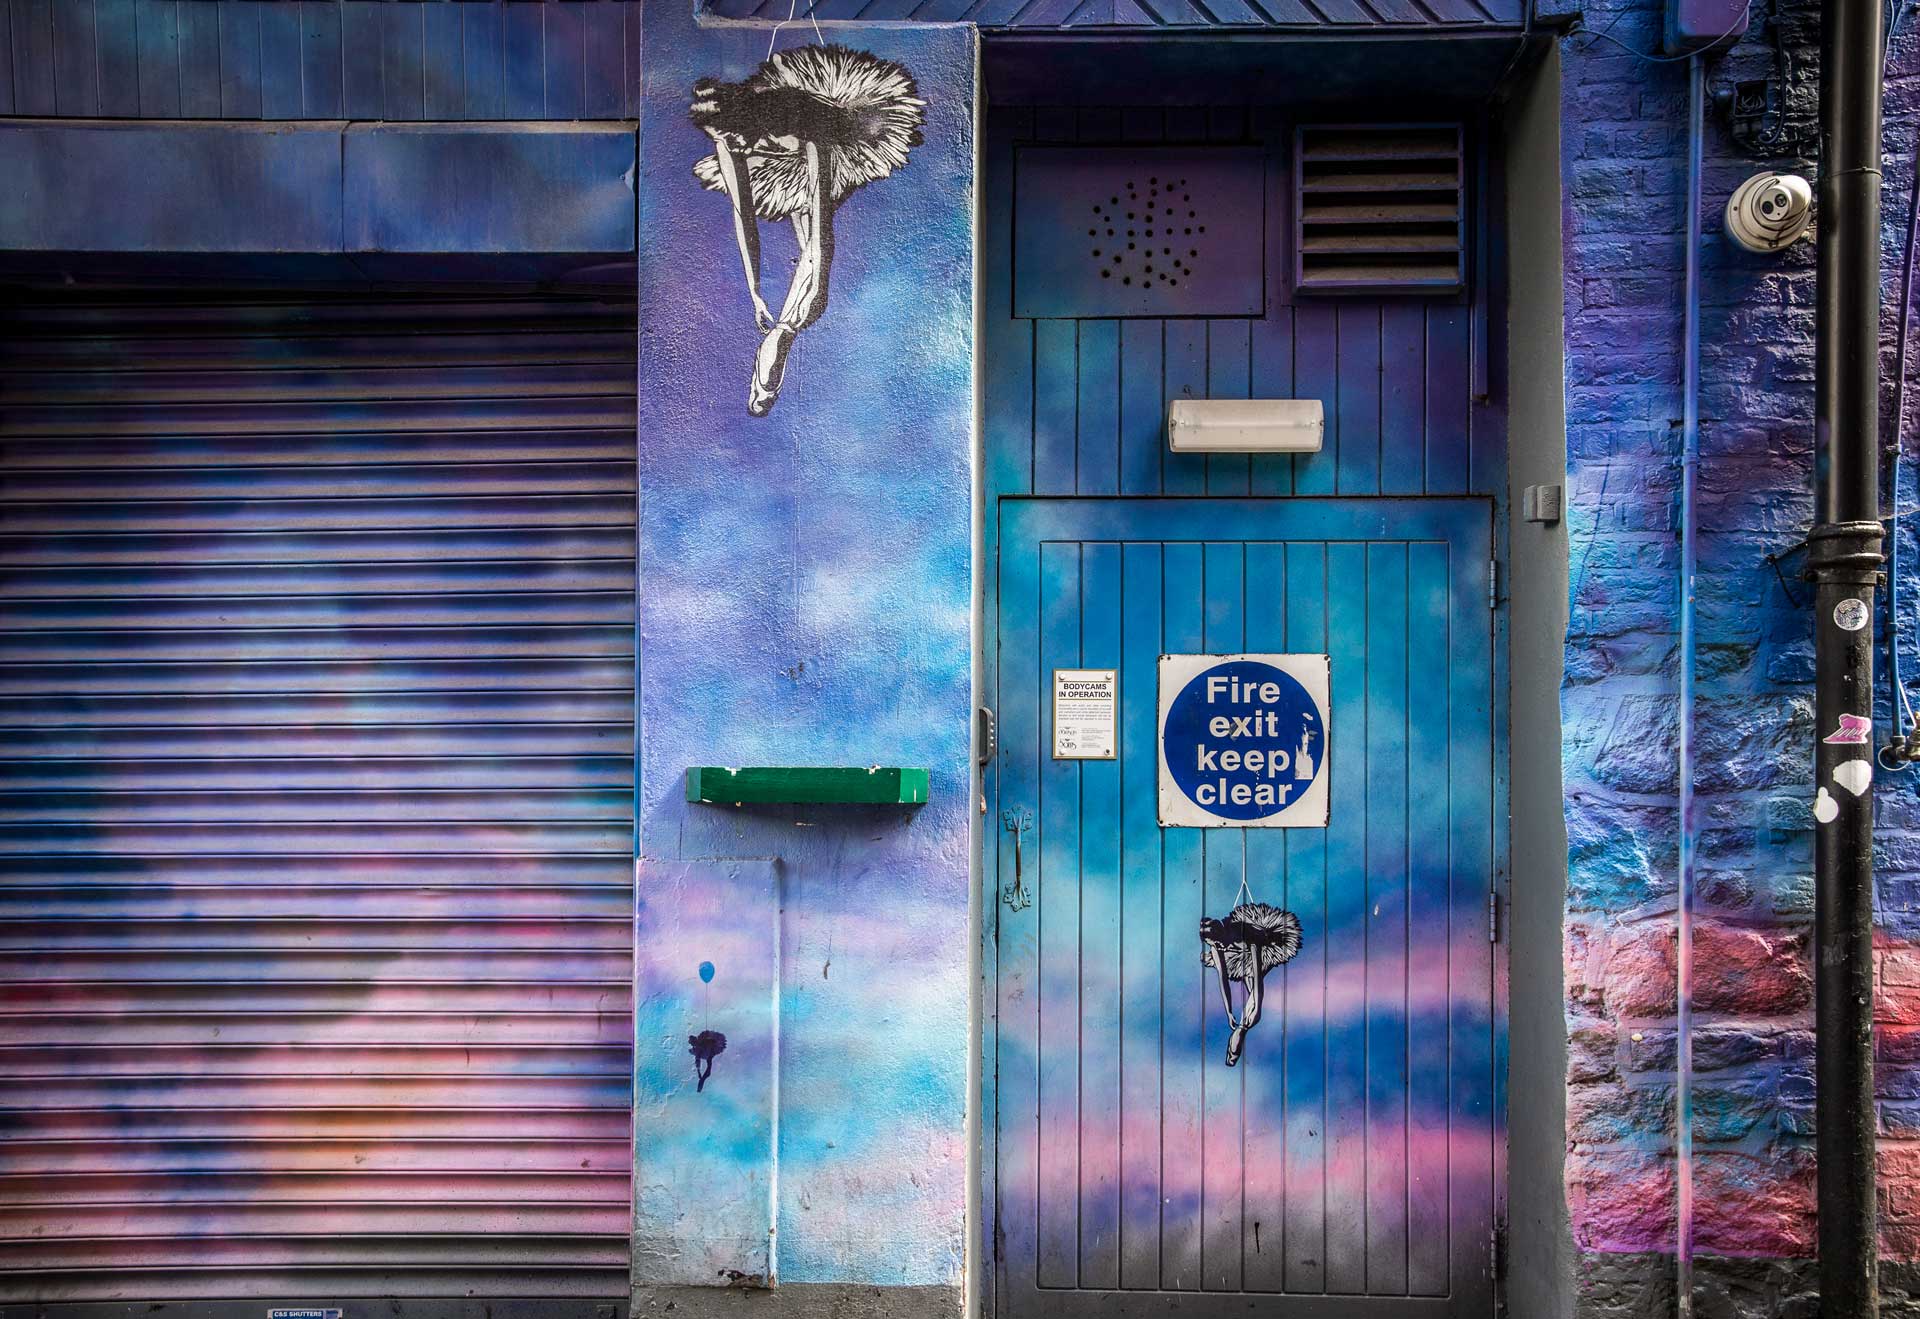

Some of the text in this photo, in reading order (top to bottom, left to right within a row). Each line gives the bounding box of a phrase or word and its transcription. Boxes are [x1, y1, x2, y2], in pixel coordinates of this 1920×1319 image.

[1207, 676, 1281, 703] Fire
[1209, 709, 1279, 737] exit
[1197, 744, 1291, 778] keep
[1196, 778, 1293, 805] clear
